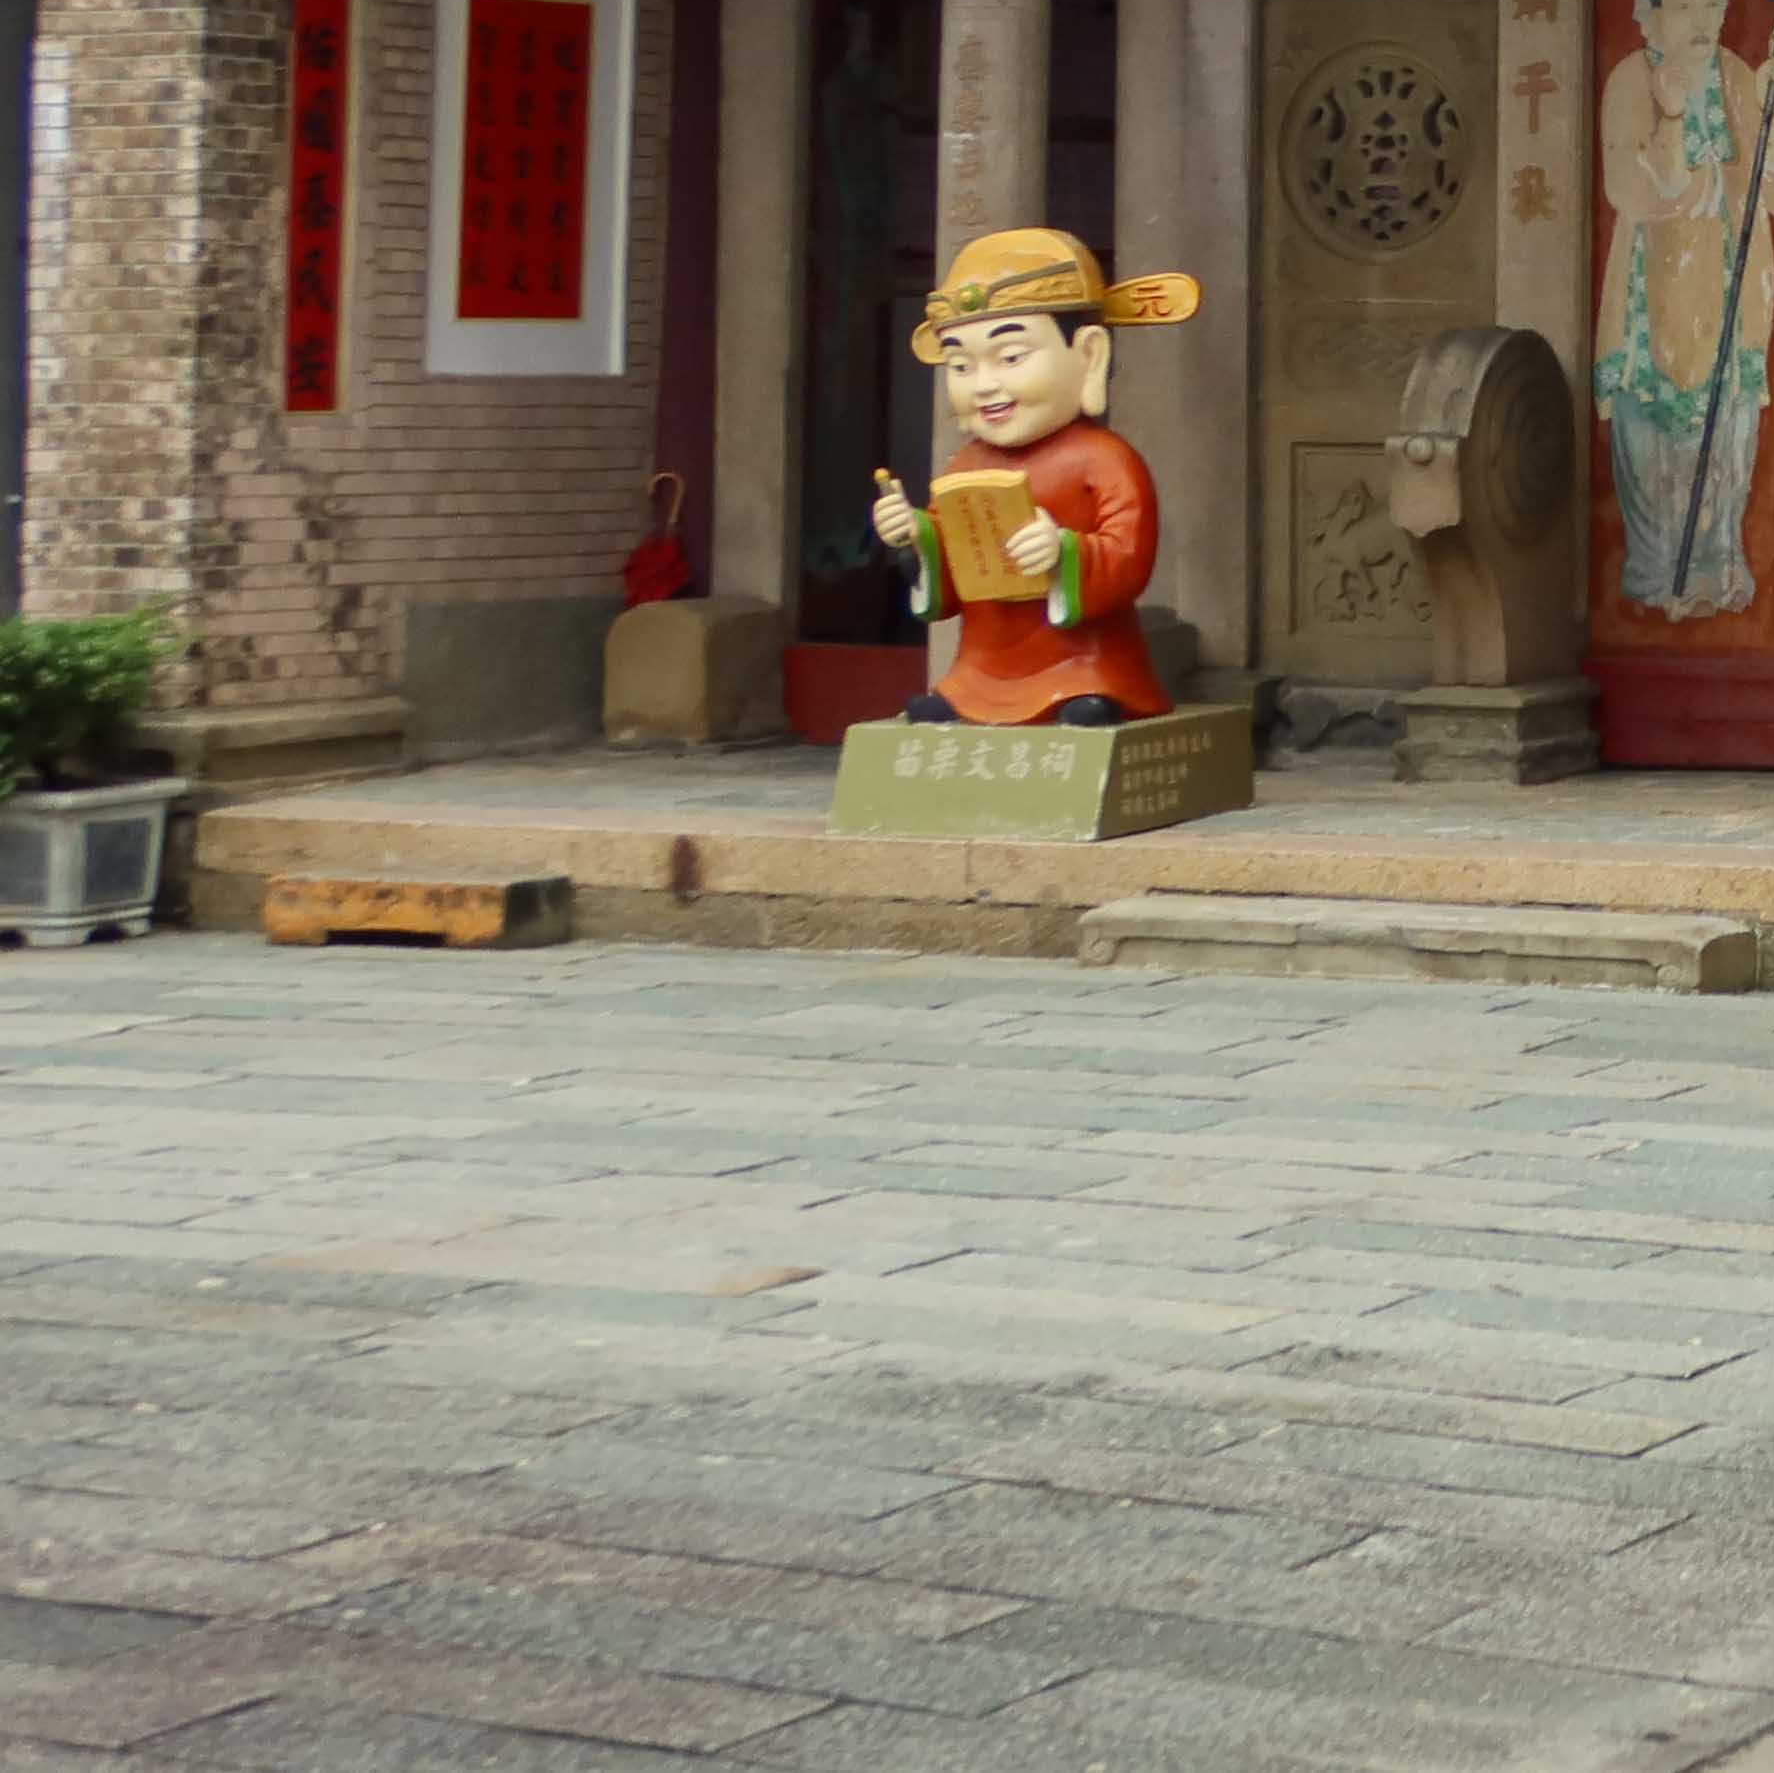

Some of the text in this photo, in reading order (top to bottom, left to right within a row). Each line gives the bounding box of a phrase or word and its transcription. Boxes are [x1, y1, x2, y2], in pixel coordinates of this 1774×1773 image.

[1130, 284, 1173, 317] 元
[894, 737, 1076, 781] 苗栗文昌祠
